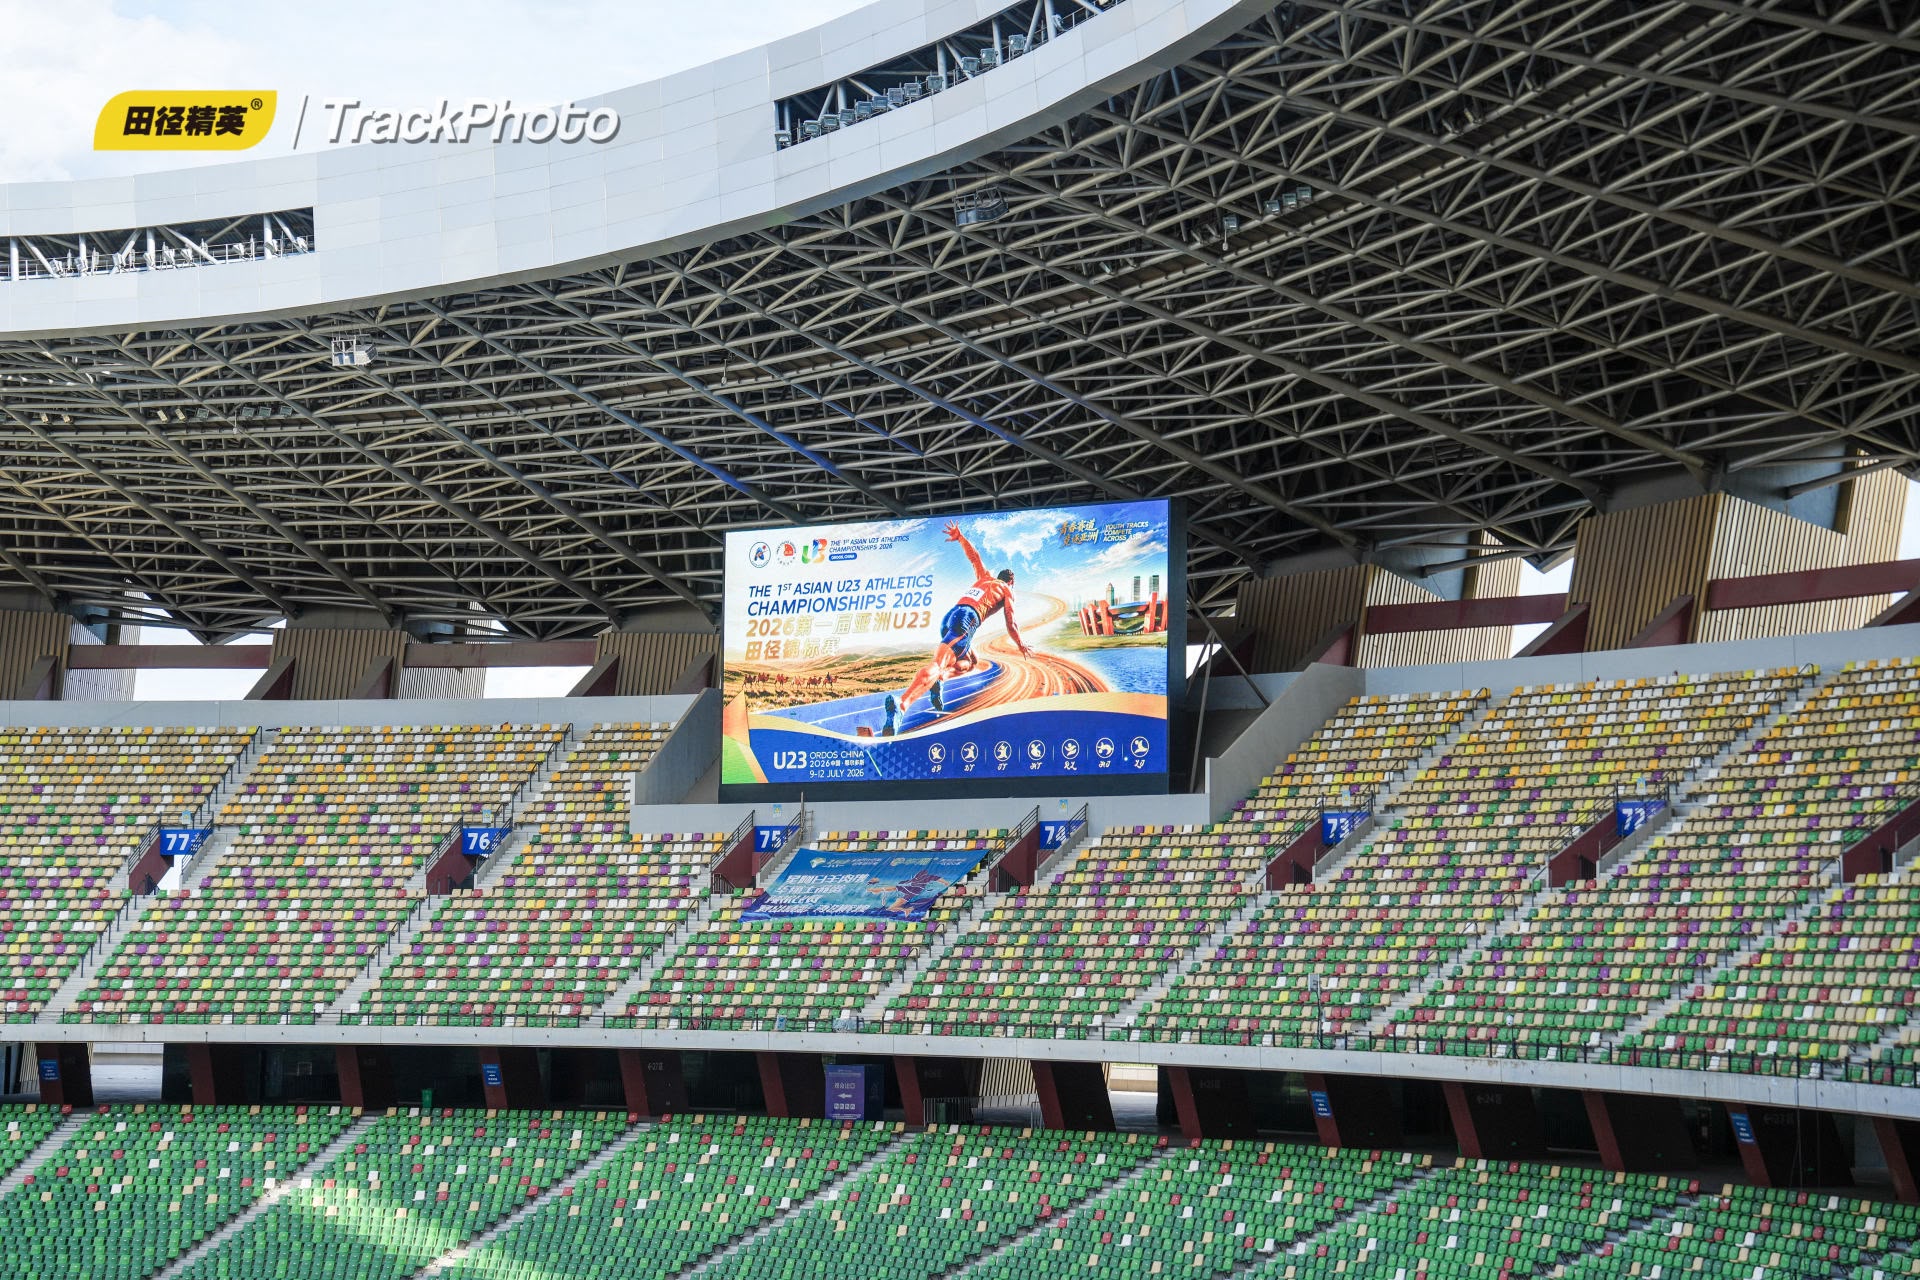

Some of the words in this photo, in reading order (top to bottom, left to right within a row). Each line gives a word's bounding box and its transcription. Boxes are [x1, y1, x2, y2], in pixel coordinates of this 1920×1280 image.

[1103, 534, 1126, 542] ACROSS
[1104, 528, 1132, 536] COMPETE
[829, 544, 878, 554] CHAMPIONSHIPS
[879, 542, 893, 550] 2026
[749, 585, 772, 598] THE
[793, 581, 833, 596] ASIAN
[837, 579, 861, 593] U23
[865, 574, 934, 591] ATHLETICS
[747, 593, 887, 617] CHAMPIONSHIPS
[892, 590, 933, 609] 2026
[744, 637, 841, 661] 田径锦标赛
[773, 751, 808, 770] U23
[840, 750, 865, 758] CHINA
[809, 770, 825, 778] 9-12
[826, 769, 845, 778] JULY
[847, 768, 865, 777] 2026
[1621, 808, 1645, 830] 72
[1044, 826, 1066, 845] 74
[1327, 818, 1350, 838] 73
[166, 834, 190, 850] 77
[467, 833, 490, 850] 76
[760, 831, 781, 848] 75
